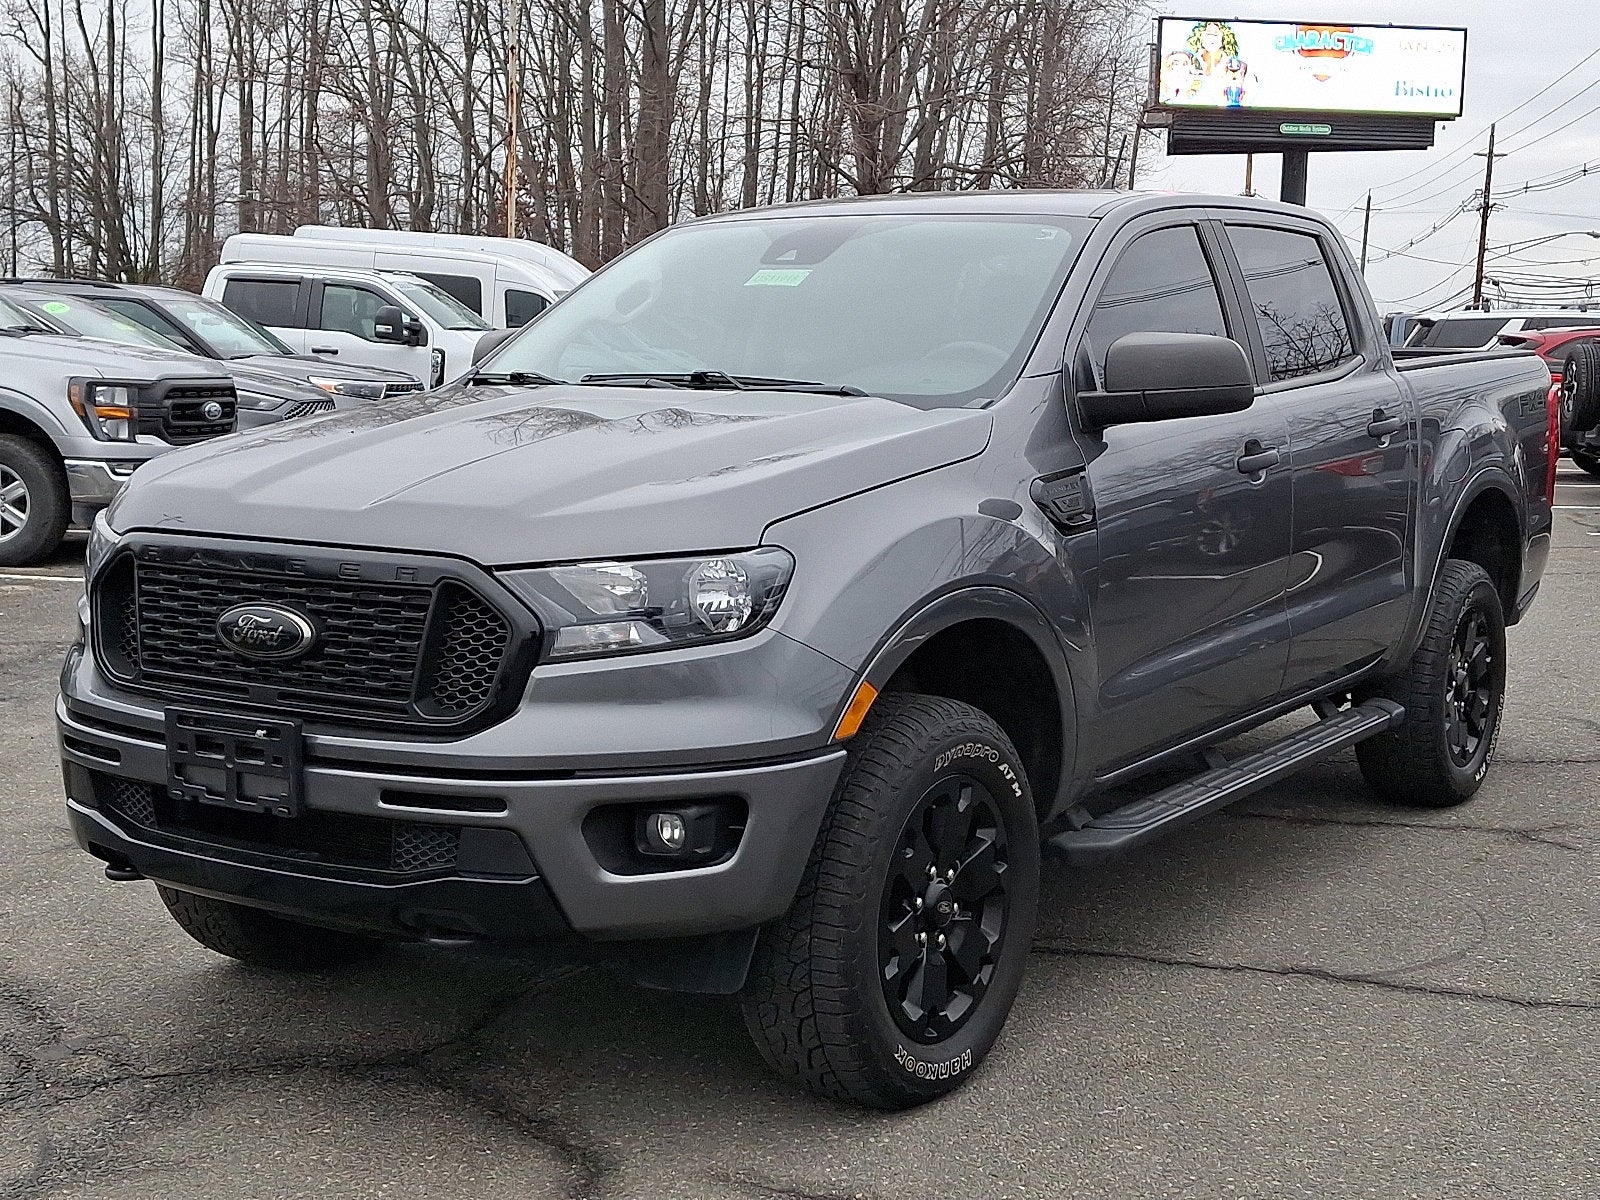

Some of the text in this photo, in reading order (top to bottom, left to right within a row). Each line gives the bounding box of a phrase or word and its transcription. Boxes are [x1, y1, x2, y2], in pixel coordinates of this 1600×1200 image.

[1274, 29, 1374, 54] CHARACTER
[1394, 80, 1455, 97] Bistro
[1517, 386, 1546, 419] FX4
[232, 612, 284, 647] Ford
